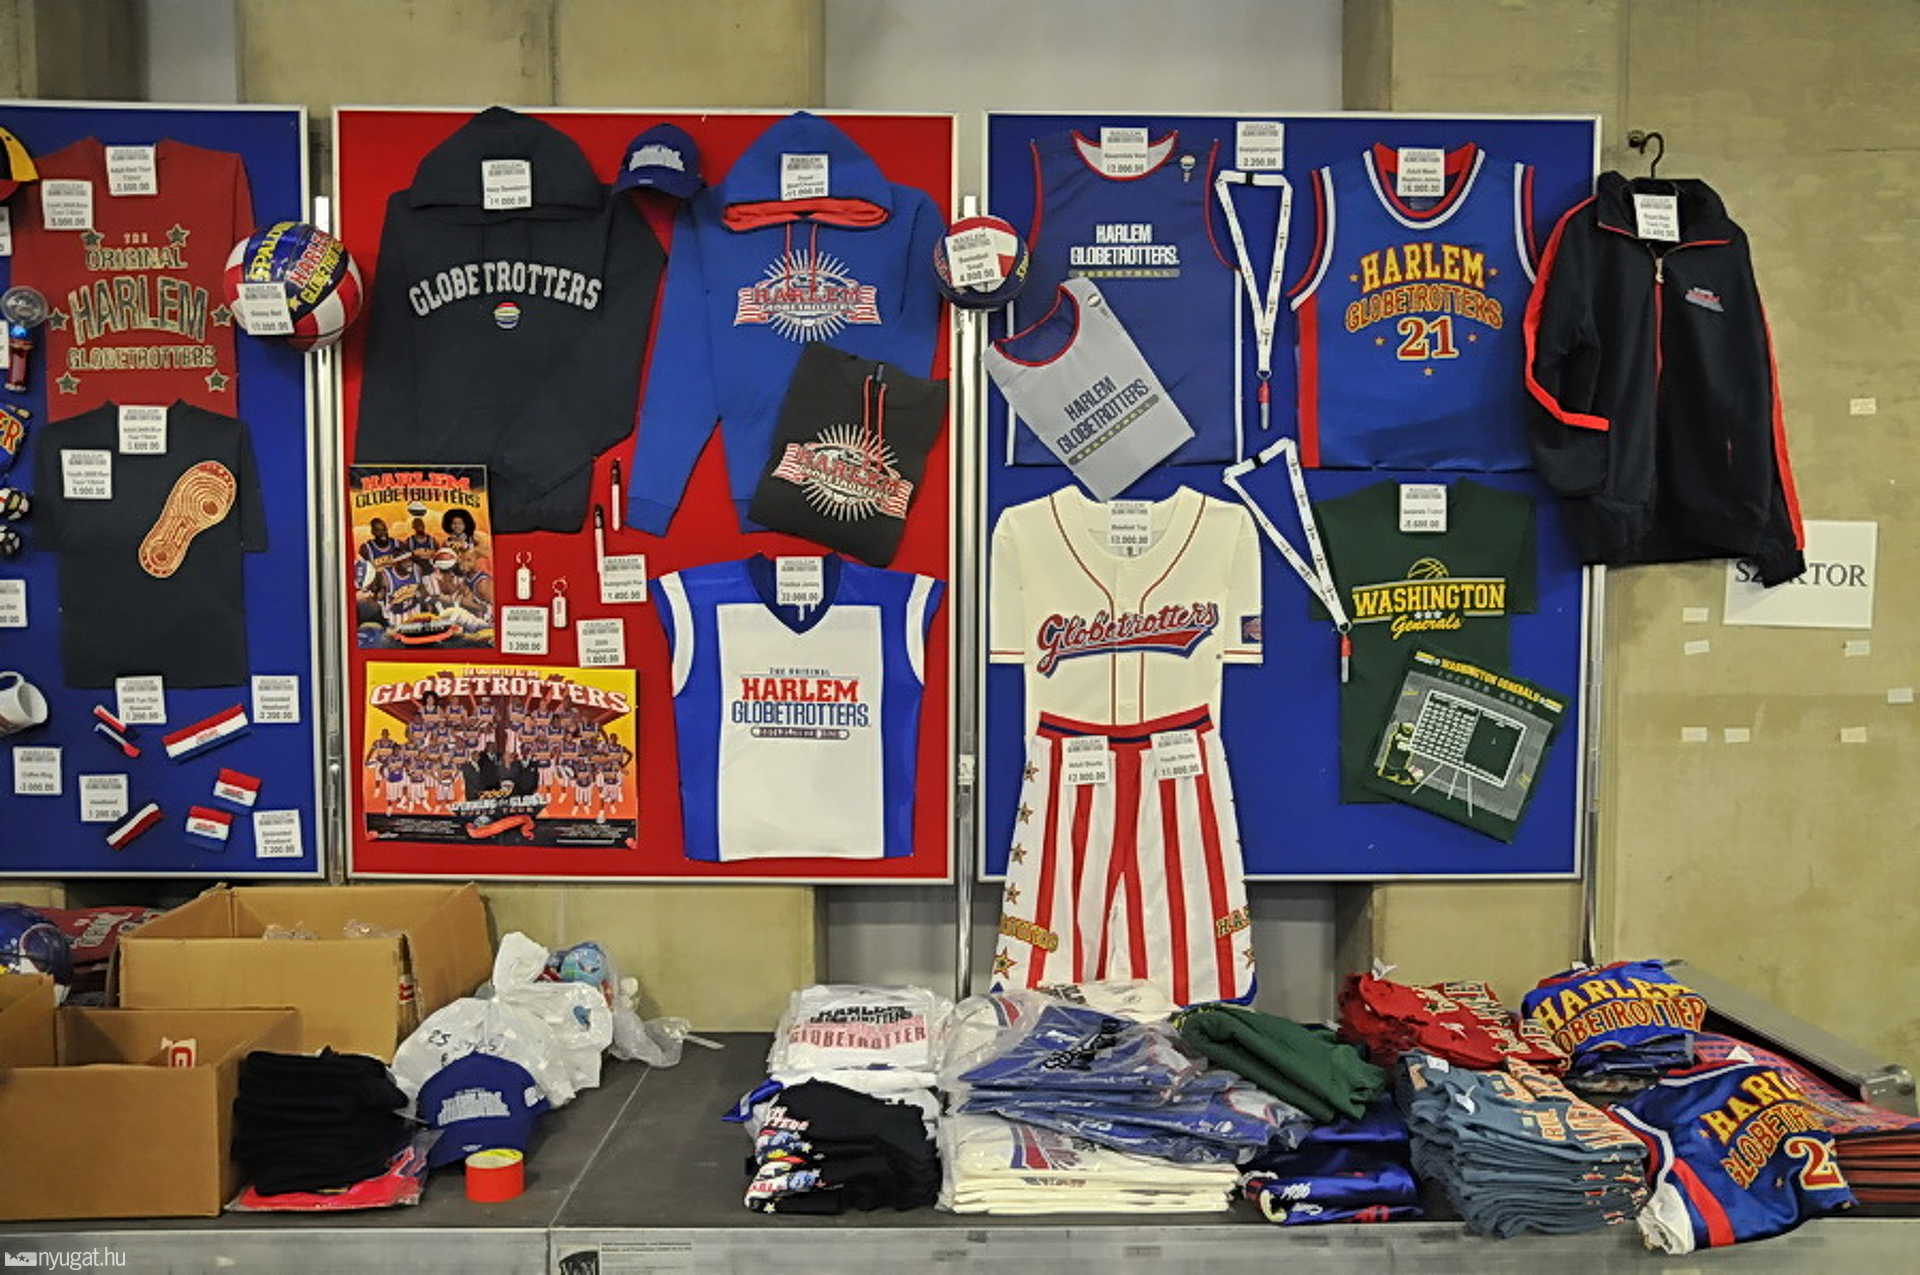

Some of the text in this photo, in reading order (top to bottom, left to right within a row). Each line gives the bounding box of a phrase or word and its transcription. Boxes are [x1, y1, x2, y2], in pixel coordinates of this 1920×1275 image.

[1095, 223, 1153, 244] HARLEM
[85, 246, 188, 271] ORIGINAL
[1360, 243, 1486, 294] HARLEM
[408, 260, 603, 317] GLOBETROTTERS
[1345, 282, 1504, 331] GLOBETROTTERS
[67, 275, 209, 346] HARLEM
[1396, 315, 1460, 361] 21
[67, 345, 217, 370] GLOBETROTTERS
[1056, 378, 1150, 455] GLOBETROTTERS
[1063, 375, 1117, 423] HARLEM
[355, 486, 481, 508] GLOBETROTTERS
[361, 471, 472, 491] HARLEM
[1352, 583, 1506, 618] WASHINGTON
[1036, 601, 1219, 678] Globetrotters
[1390, 612, 1463, 640] Generals
[369, 675, 632, 714] GLOBETROTTERS
[741, 677, 859, 702] HARLEM
[731, 700, 869, 727] GLOBETROTTERS
